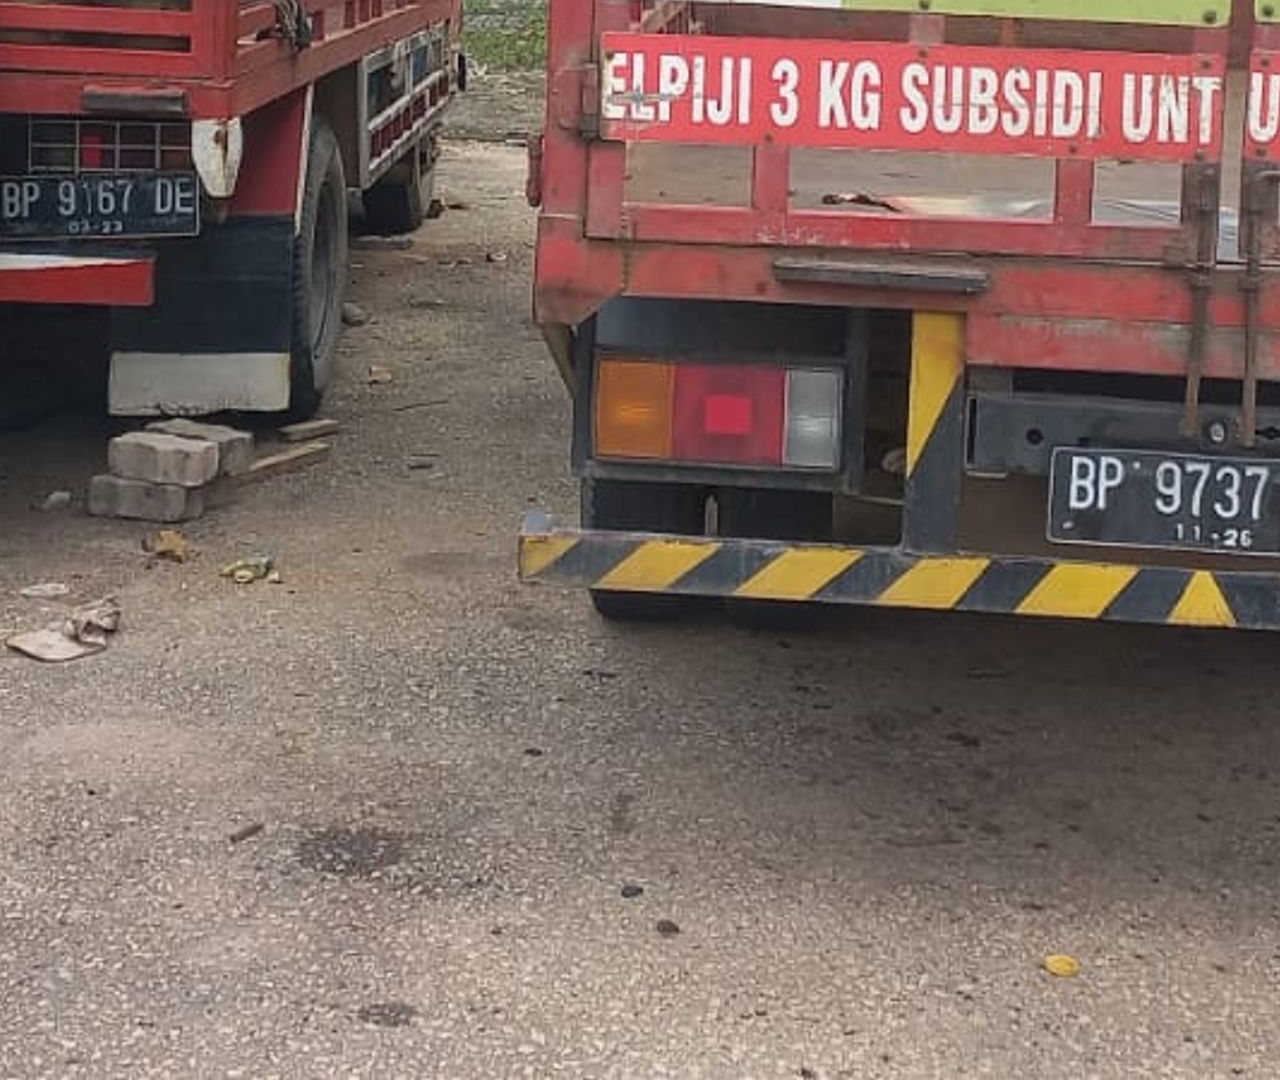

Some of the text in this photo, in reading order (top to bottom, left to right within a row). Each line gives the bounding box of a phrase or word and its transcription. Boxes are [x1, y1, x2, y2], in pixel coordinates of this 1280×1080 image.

[602, 52, 752, 124] ELPIJI
[771, 58, 799, 127] 3
[819, 60, 883, 131] KG
[900, 63, 1102, 139] SUBSIDI
[2, 178, 194, 218] BP 9167 DE
[1069, 456, 1124, 510] BP
[1155, 461, 1269, 520] 9737
